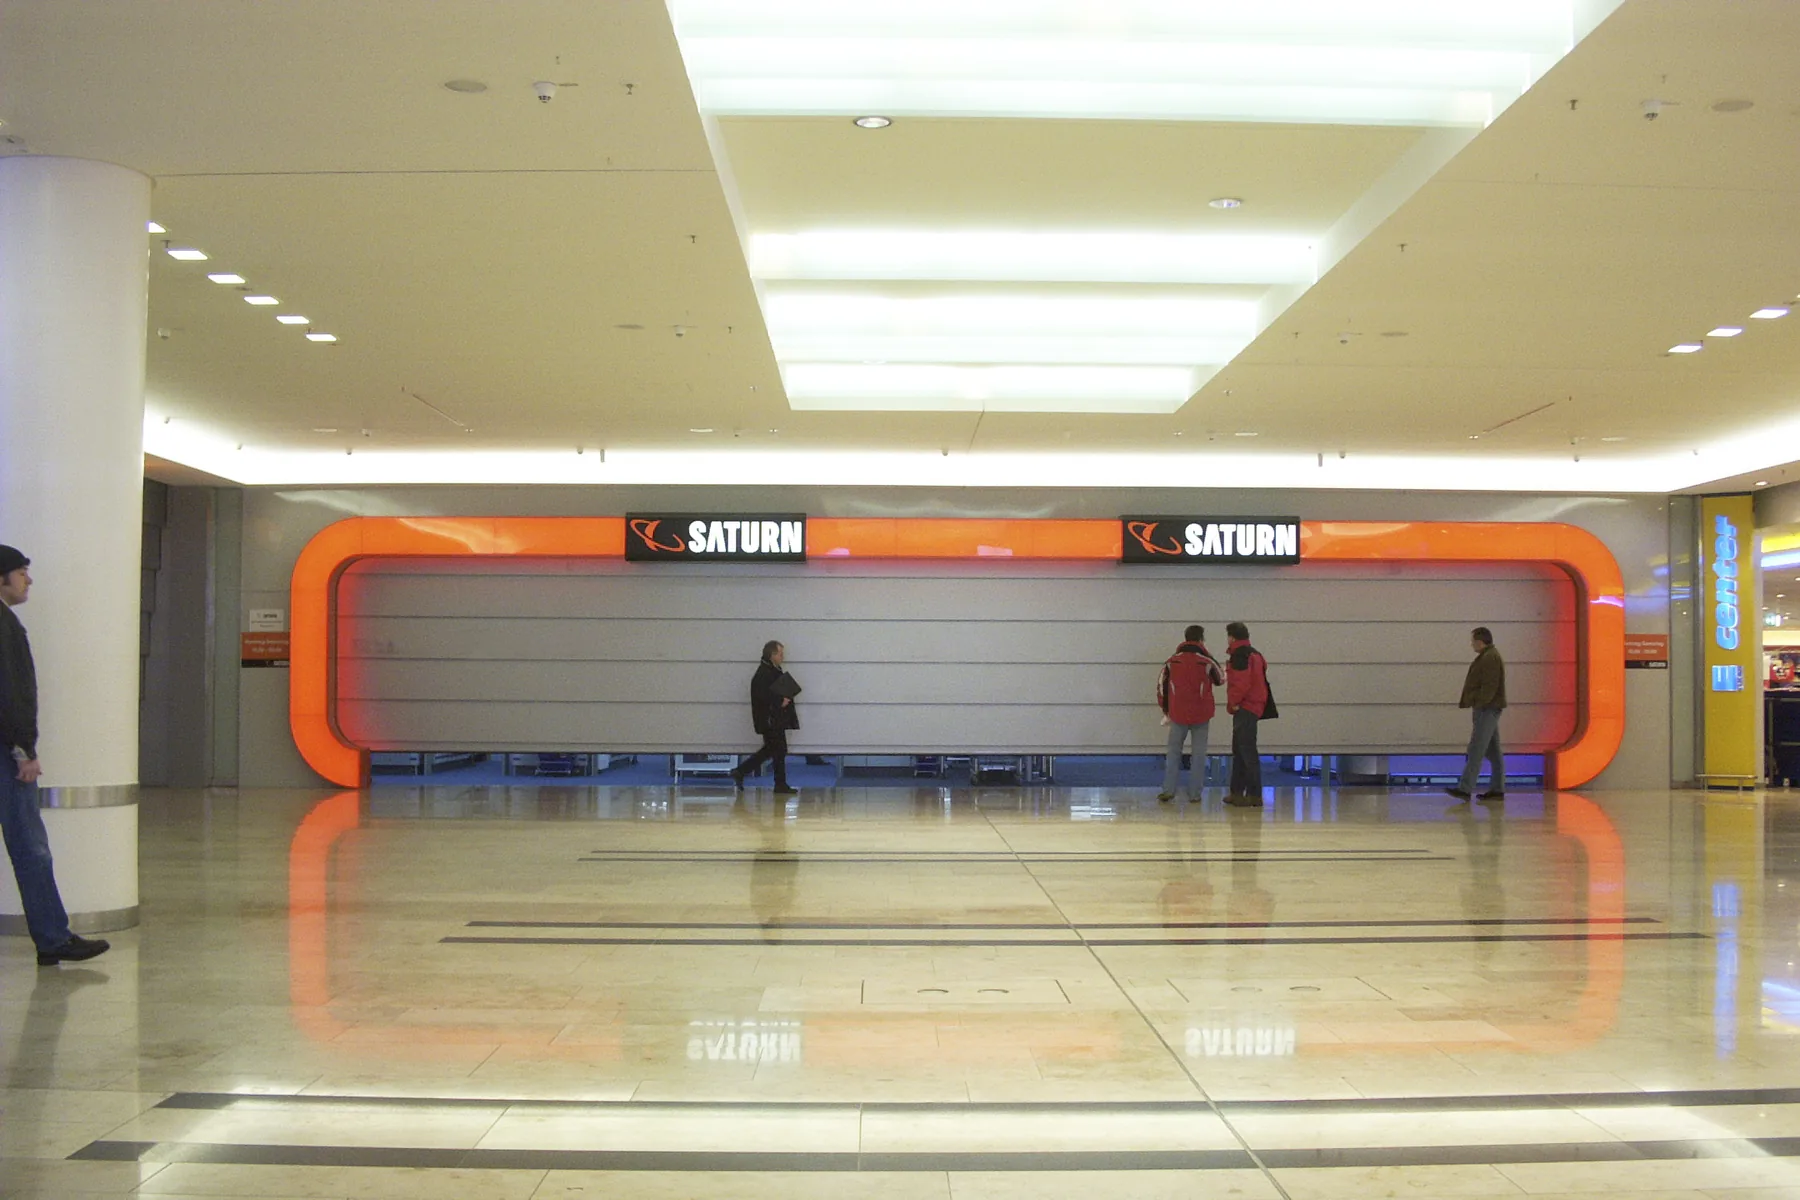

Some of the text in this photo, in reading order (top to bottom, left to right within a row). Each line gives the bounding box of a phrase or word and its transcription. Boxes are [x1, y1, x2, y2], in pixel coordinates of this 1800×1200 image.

[688, 520, 802, 554] SATURN
[1184, 523, 1296, 556] SATURN
[1712, 515, 1739, 650] center
